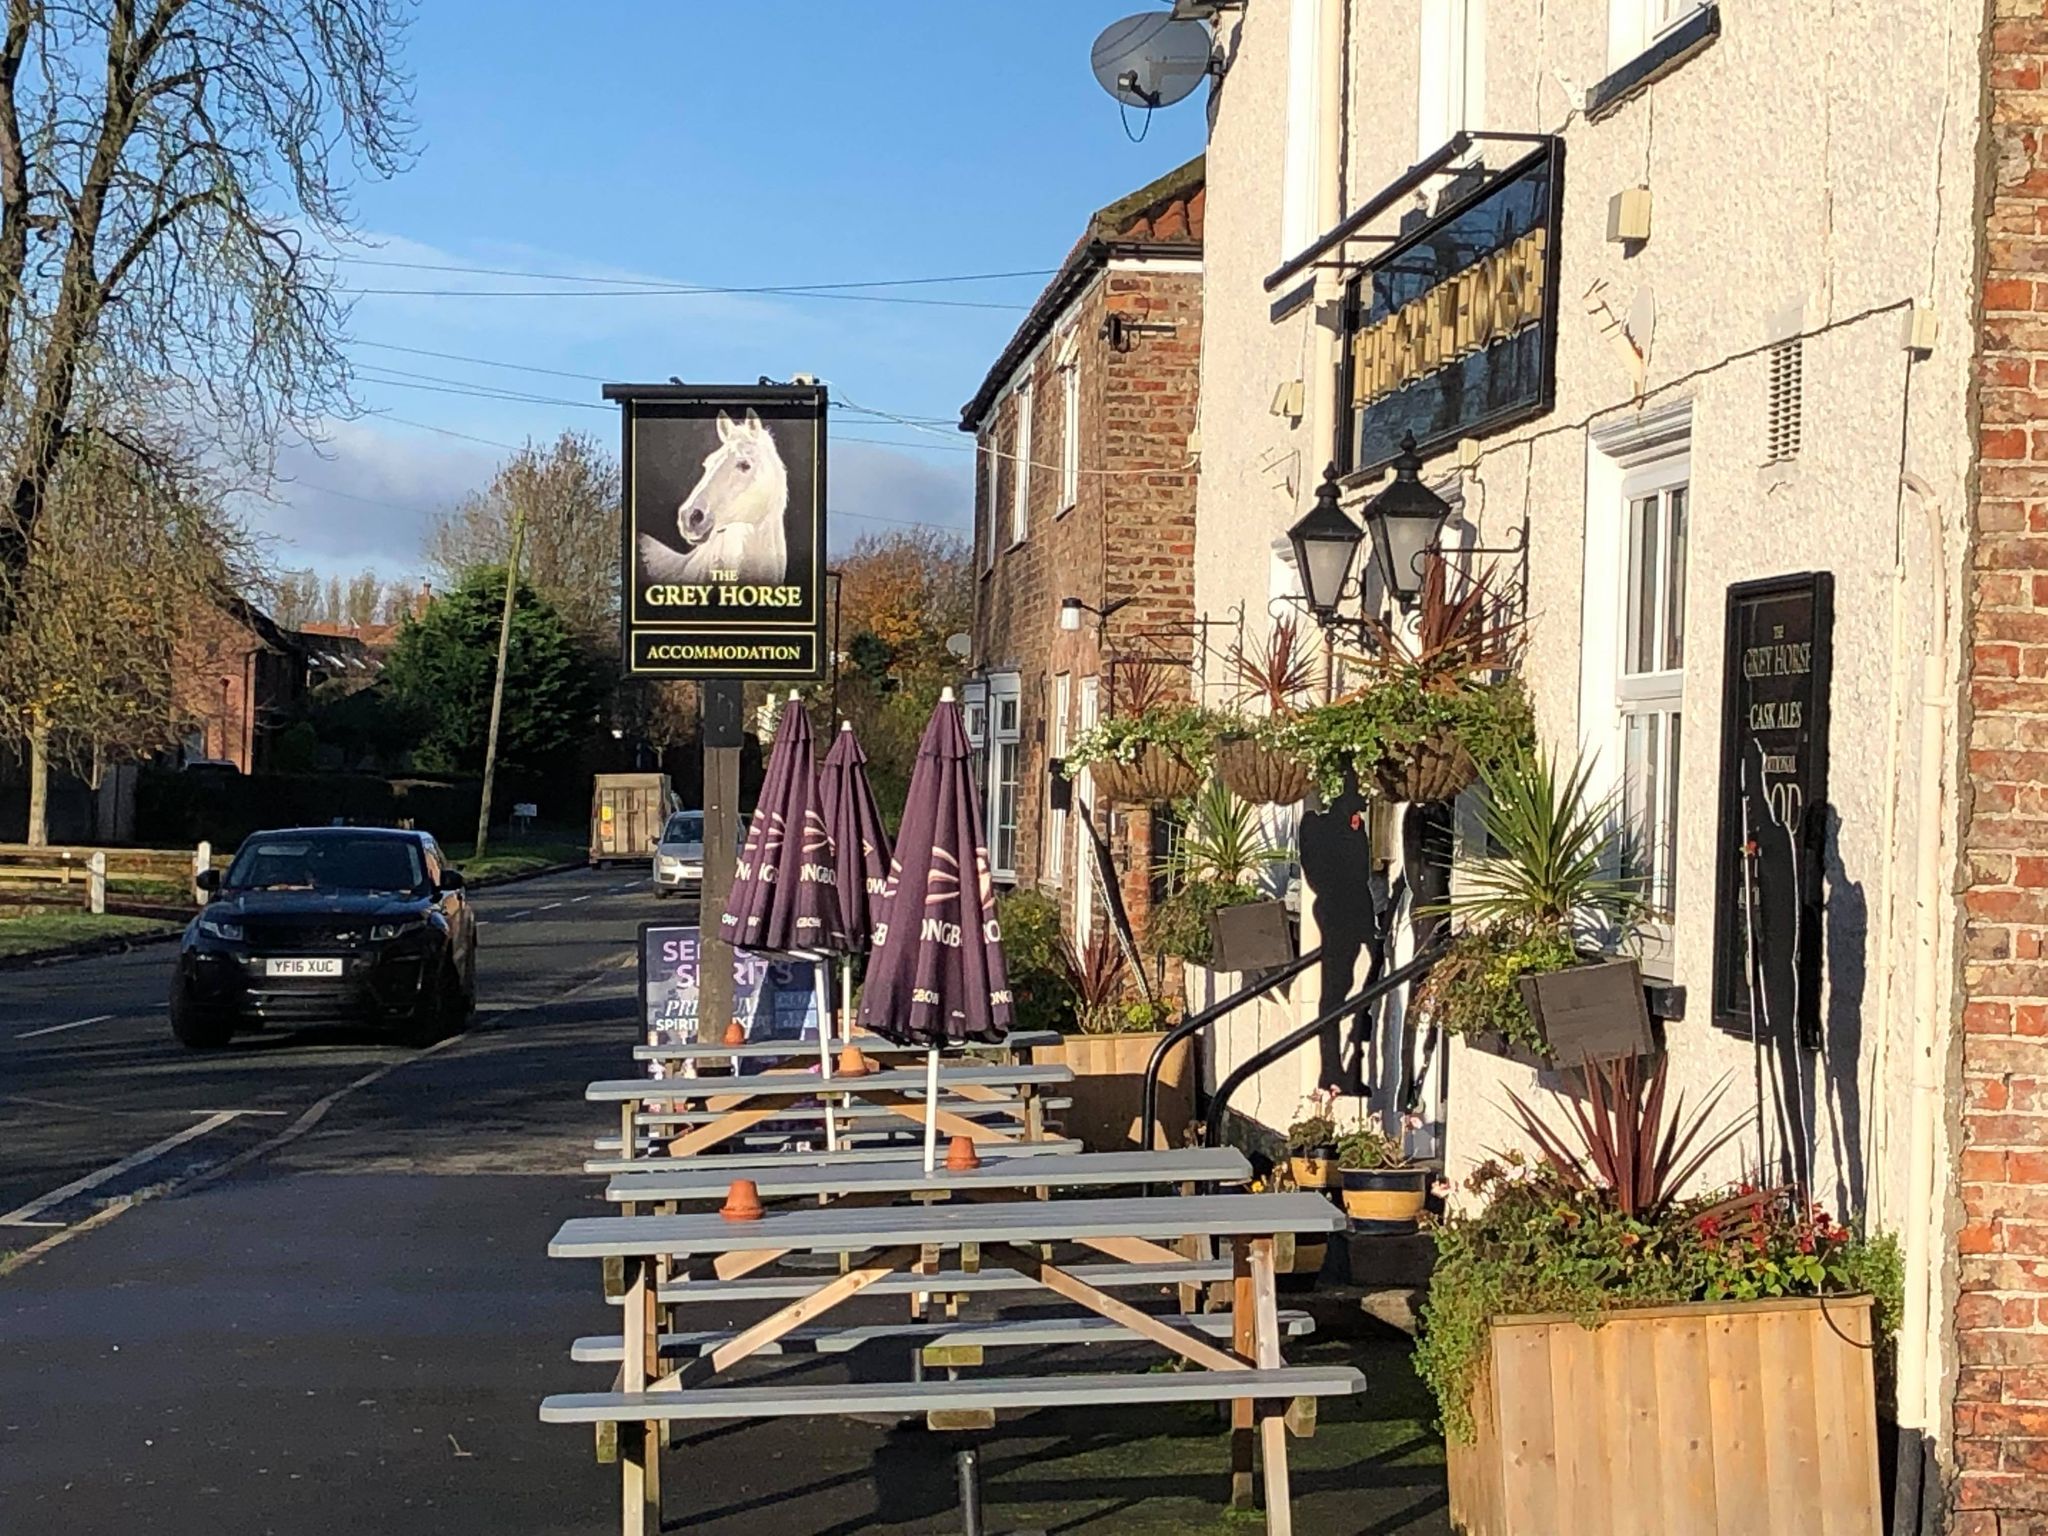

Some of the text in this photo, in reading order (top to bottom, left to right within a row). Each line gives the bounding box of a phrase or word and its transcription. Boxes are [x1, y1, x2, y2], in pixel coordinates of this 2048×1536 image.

[711, 569, 739, 582] THE
[645, 584, 803, 607] GREY HORSE
[646, 645, 801, 660] ACCOMMODATION
[1750, 701, 1802, 731] CASK ALES
[275, 960, 333, 973] YF16 XUC
